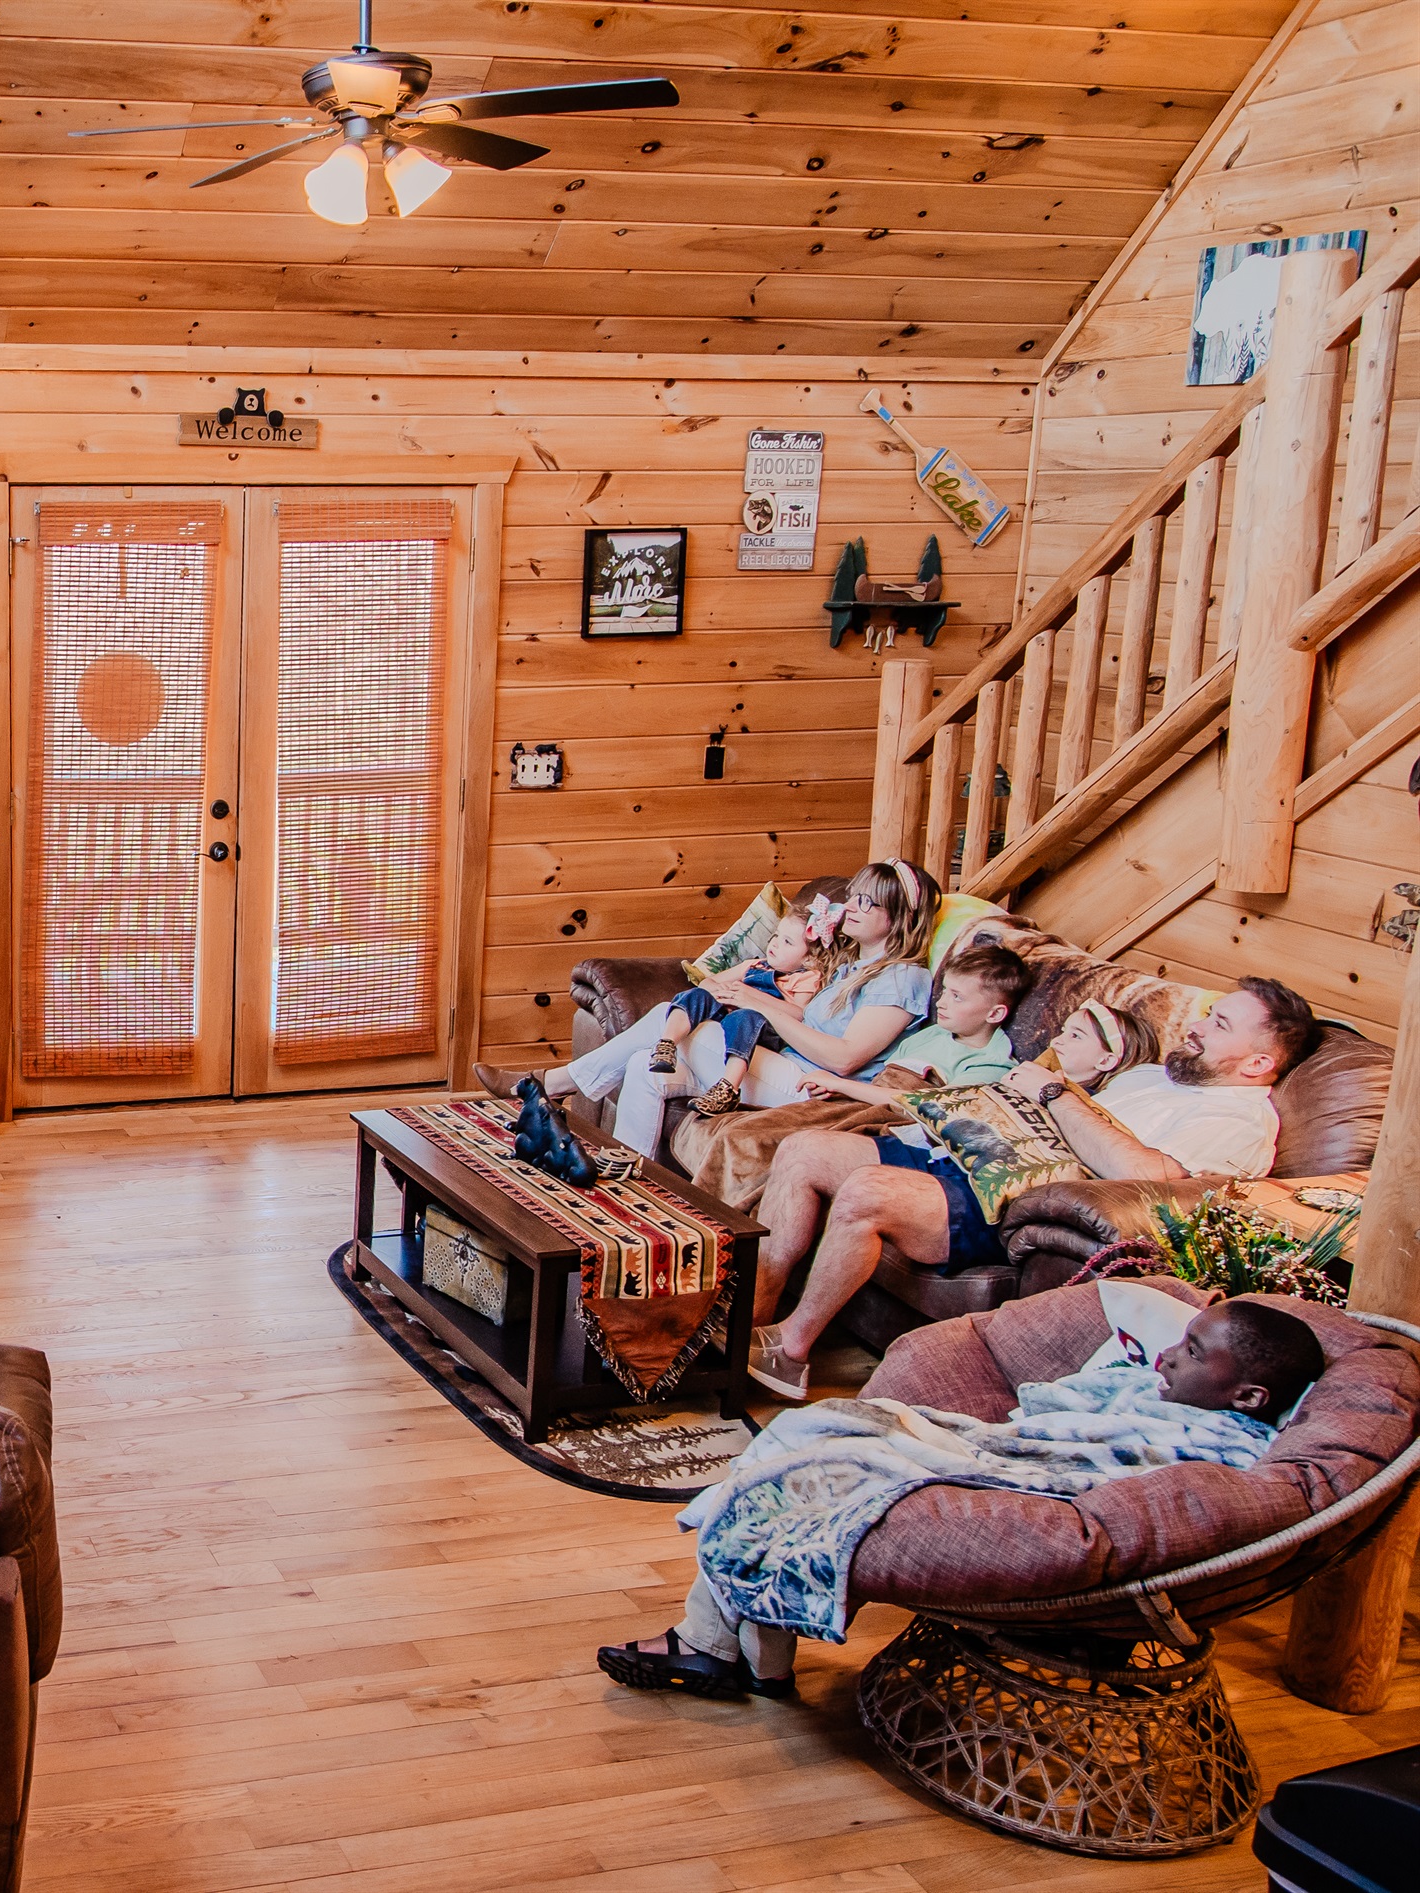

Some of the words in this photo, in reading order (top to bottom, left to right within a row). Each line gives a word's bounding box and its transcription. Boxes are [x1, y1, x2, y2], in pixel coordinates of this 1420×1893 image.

[194, 419, 303, 442] Welcome
[751, 433, 780, 449] Gone
[780, 433, 821, 450] Fishin'
[753, 457, 816, 475] HOOKED
[749, 478, 775, 487] FOR
[785, 478, 815, 487] LIFE
[927, 471, 983, 532] Lake
[779, 512, 812, 528] FISH
[743, 537, 775, 547] TACKLE
[742, 554, 768, 565] REEL
[770, 554, 811, 565] LEGEND
[603, 574, 664, 606] More
